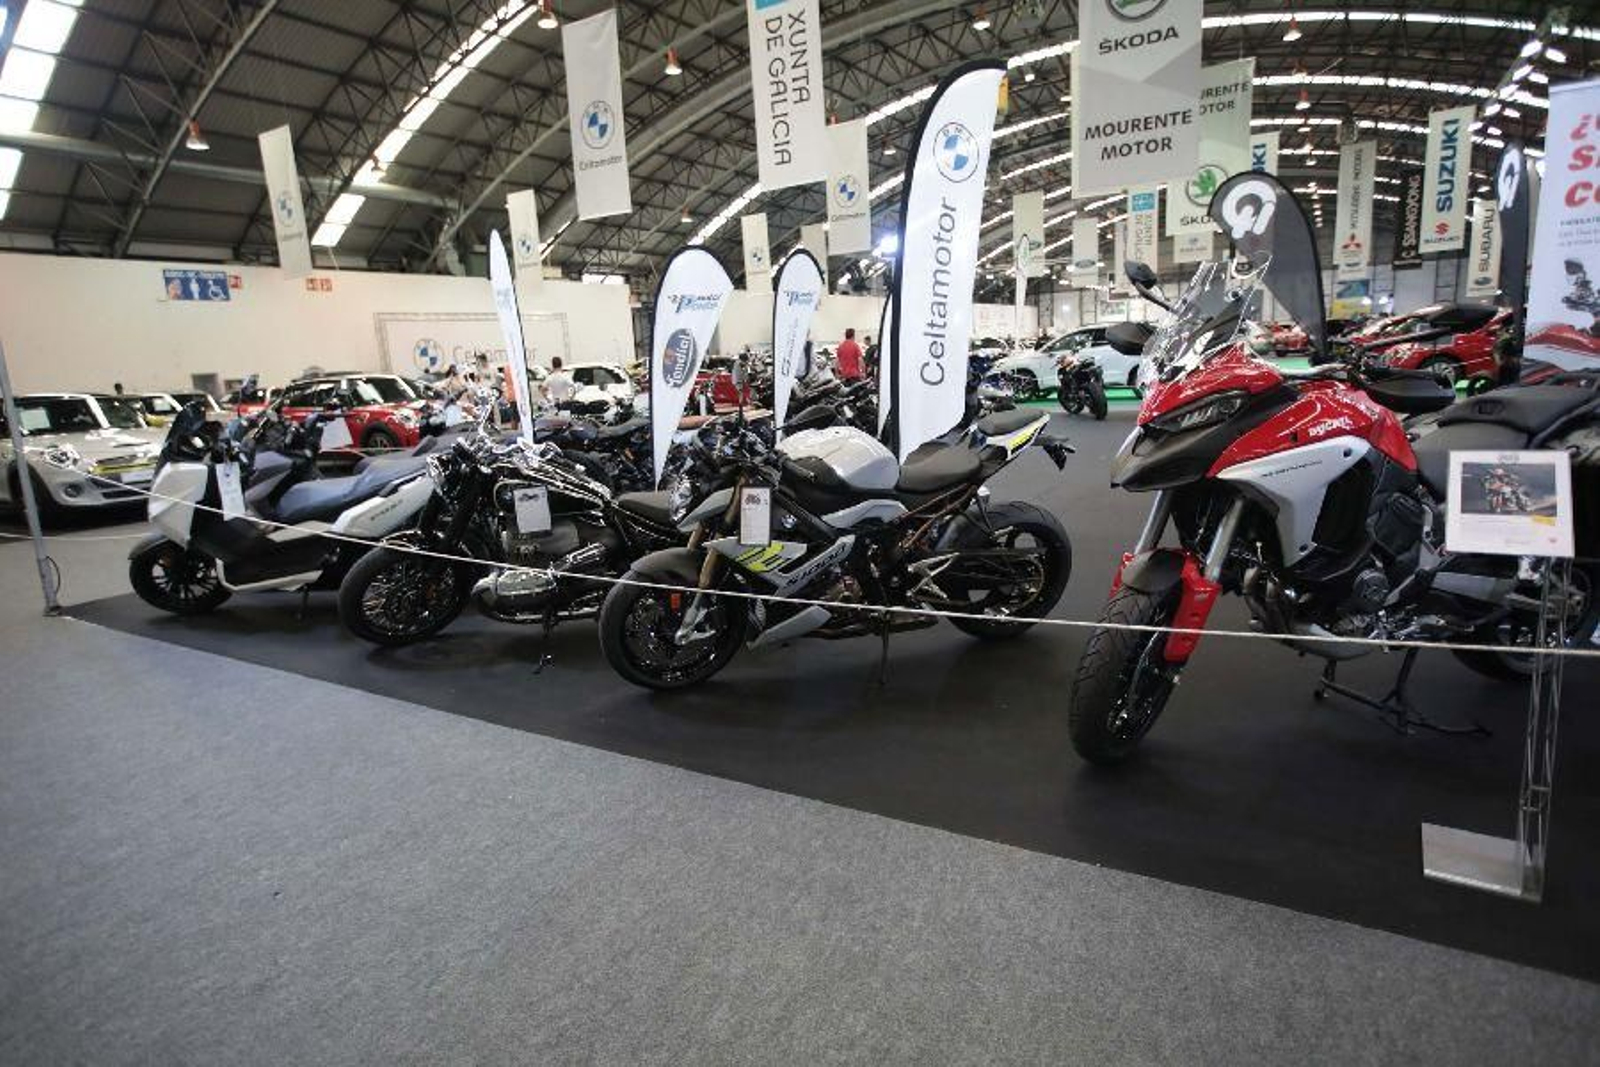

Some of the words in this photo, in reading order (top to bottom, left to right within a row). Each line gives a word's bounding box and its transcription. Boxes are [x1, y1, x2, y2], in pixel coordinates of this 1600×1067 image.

[765, 16, 785, 51] DE
[788, 9, 811, 104] XUNTA
[1099, 25, 1179, 55] ŠKODA
[768, 57, 792, 166] GALICIA
[1084, 108, 1193, 140] MOURENTE
[1100, 136, 1173, 161] MOTOR
[1436, 118, 1460, 213] SUZUKI
[1478, 208, 1495, 273] SUBARU
[920, 197, 957, 387] Celtamotor
